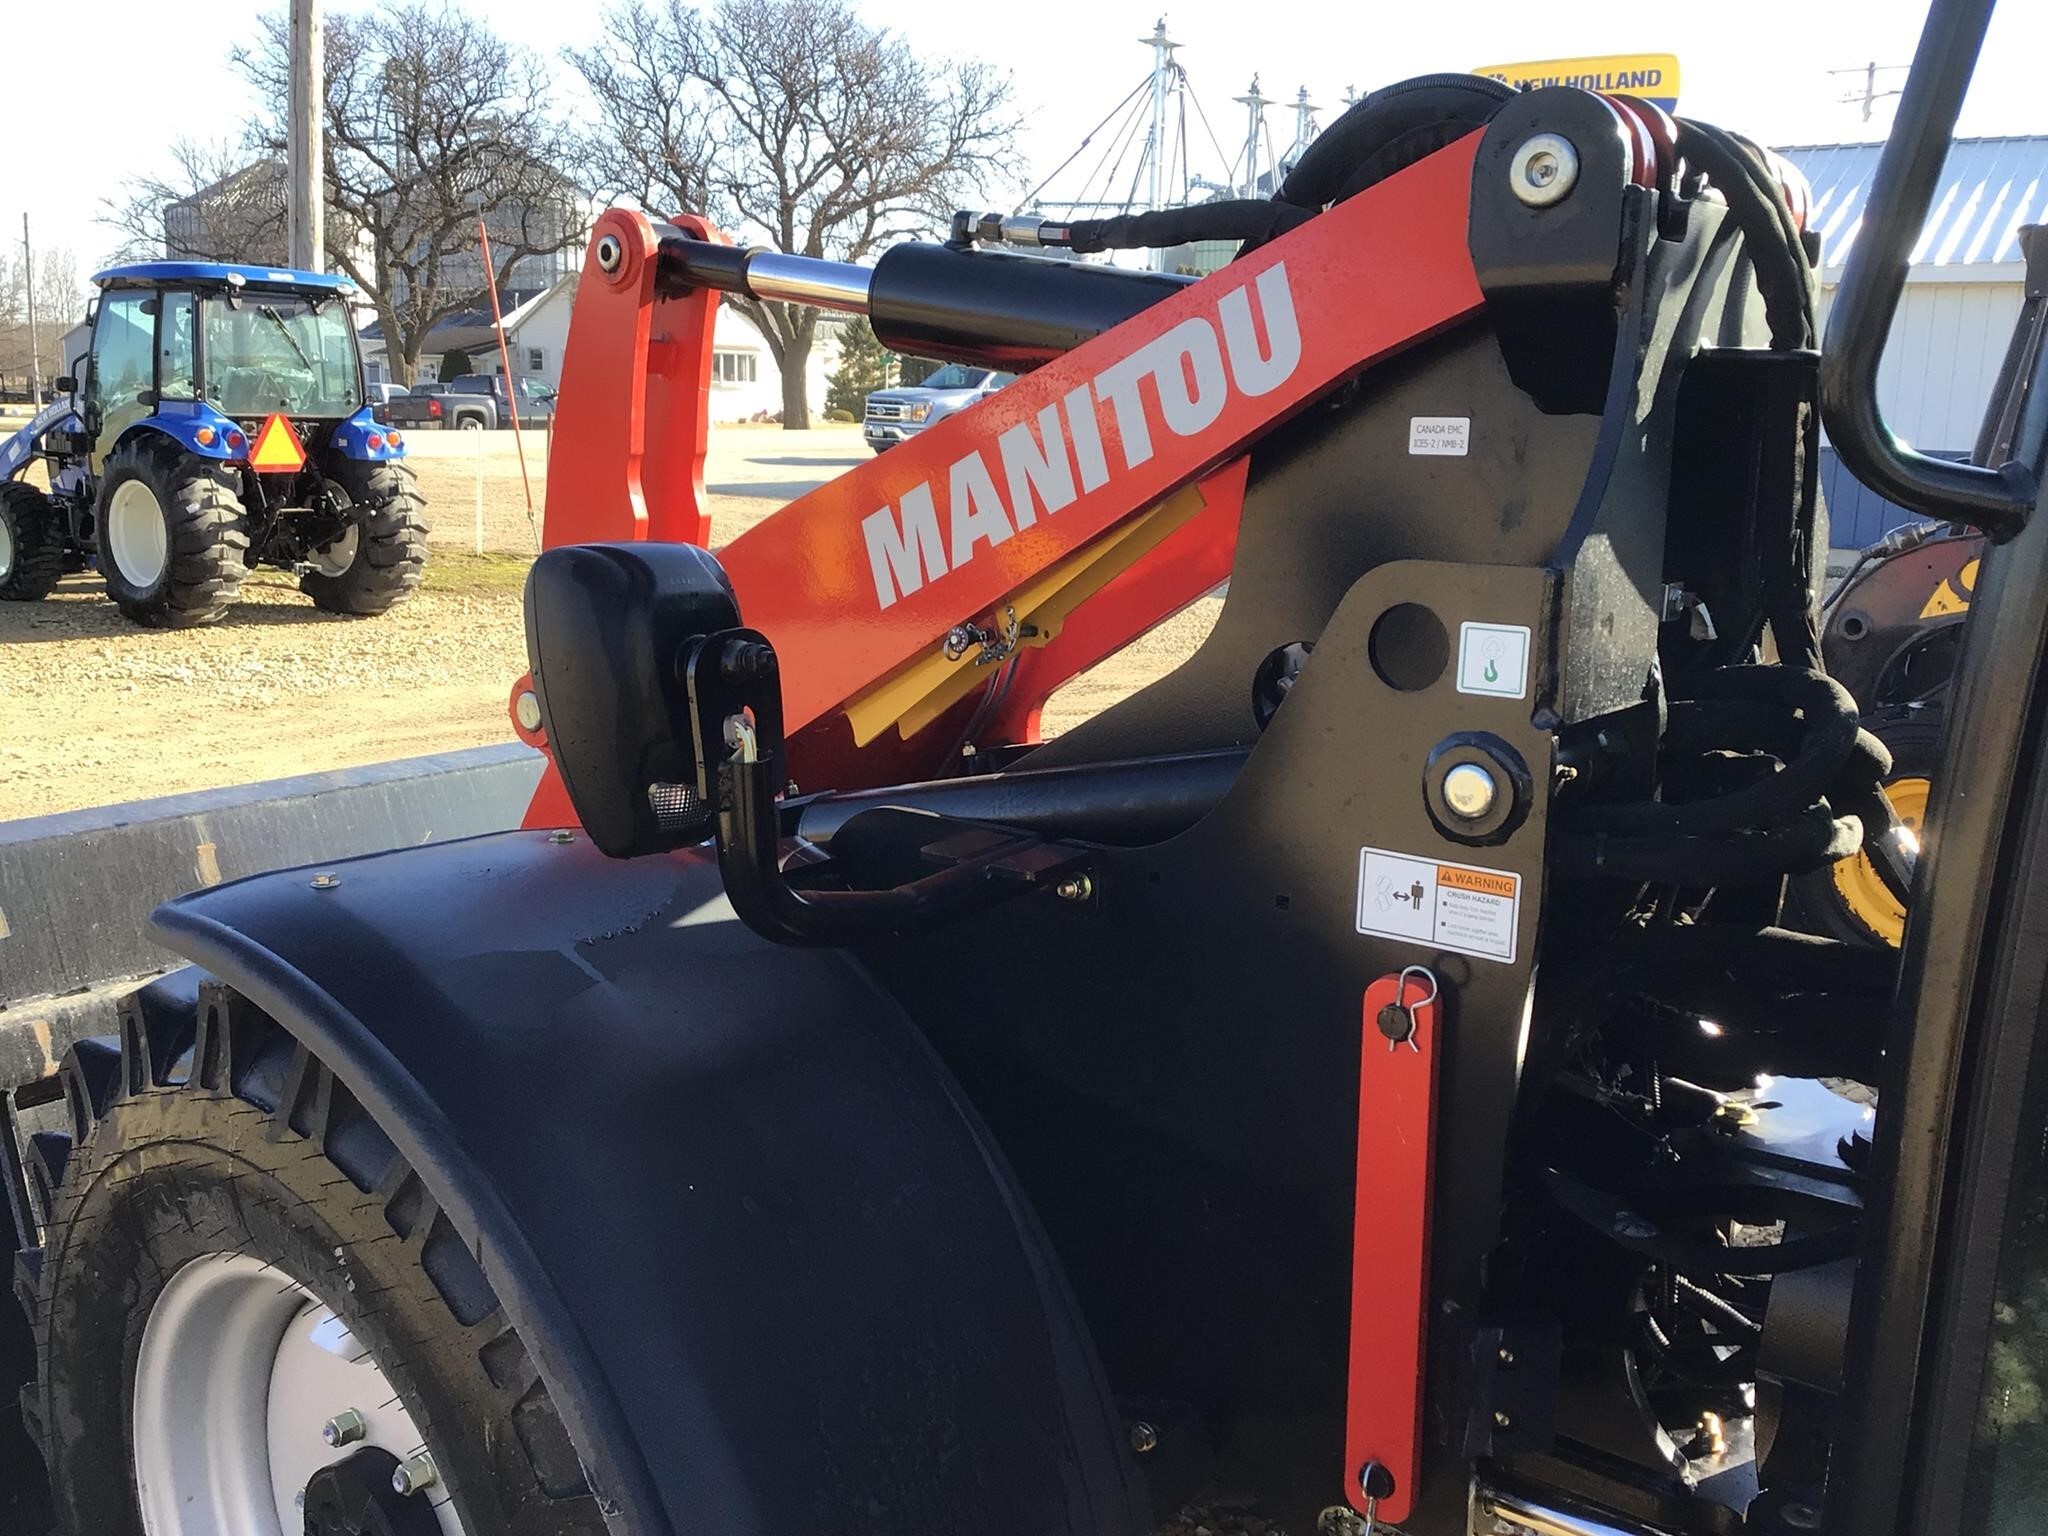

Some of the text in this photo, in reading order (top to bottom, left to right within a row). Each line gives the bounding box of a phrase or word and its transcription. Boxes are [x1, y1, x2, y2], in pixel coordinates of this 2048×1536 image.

[1566, 69, 1662, 91] HOLLAND
[861, 260, 1302, 611] MANITOU
[1416, 424, 1463, 434] CANADA EMC
[1413, 438, 1435, 448] ICES-2
[1442, 439, 1464, 449] NMB-2
[1455, 872, 1513, 893] WARNING
[1447, 890, 1501, 906] CRUSH HAZARD
